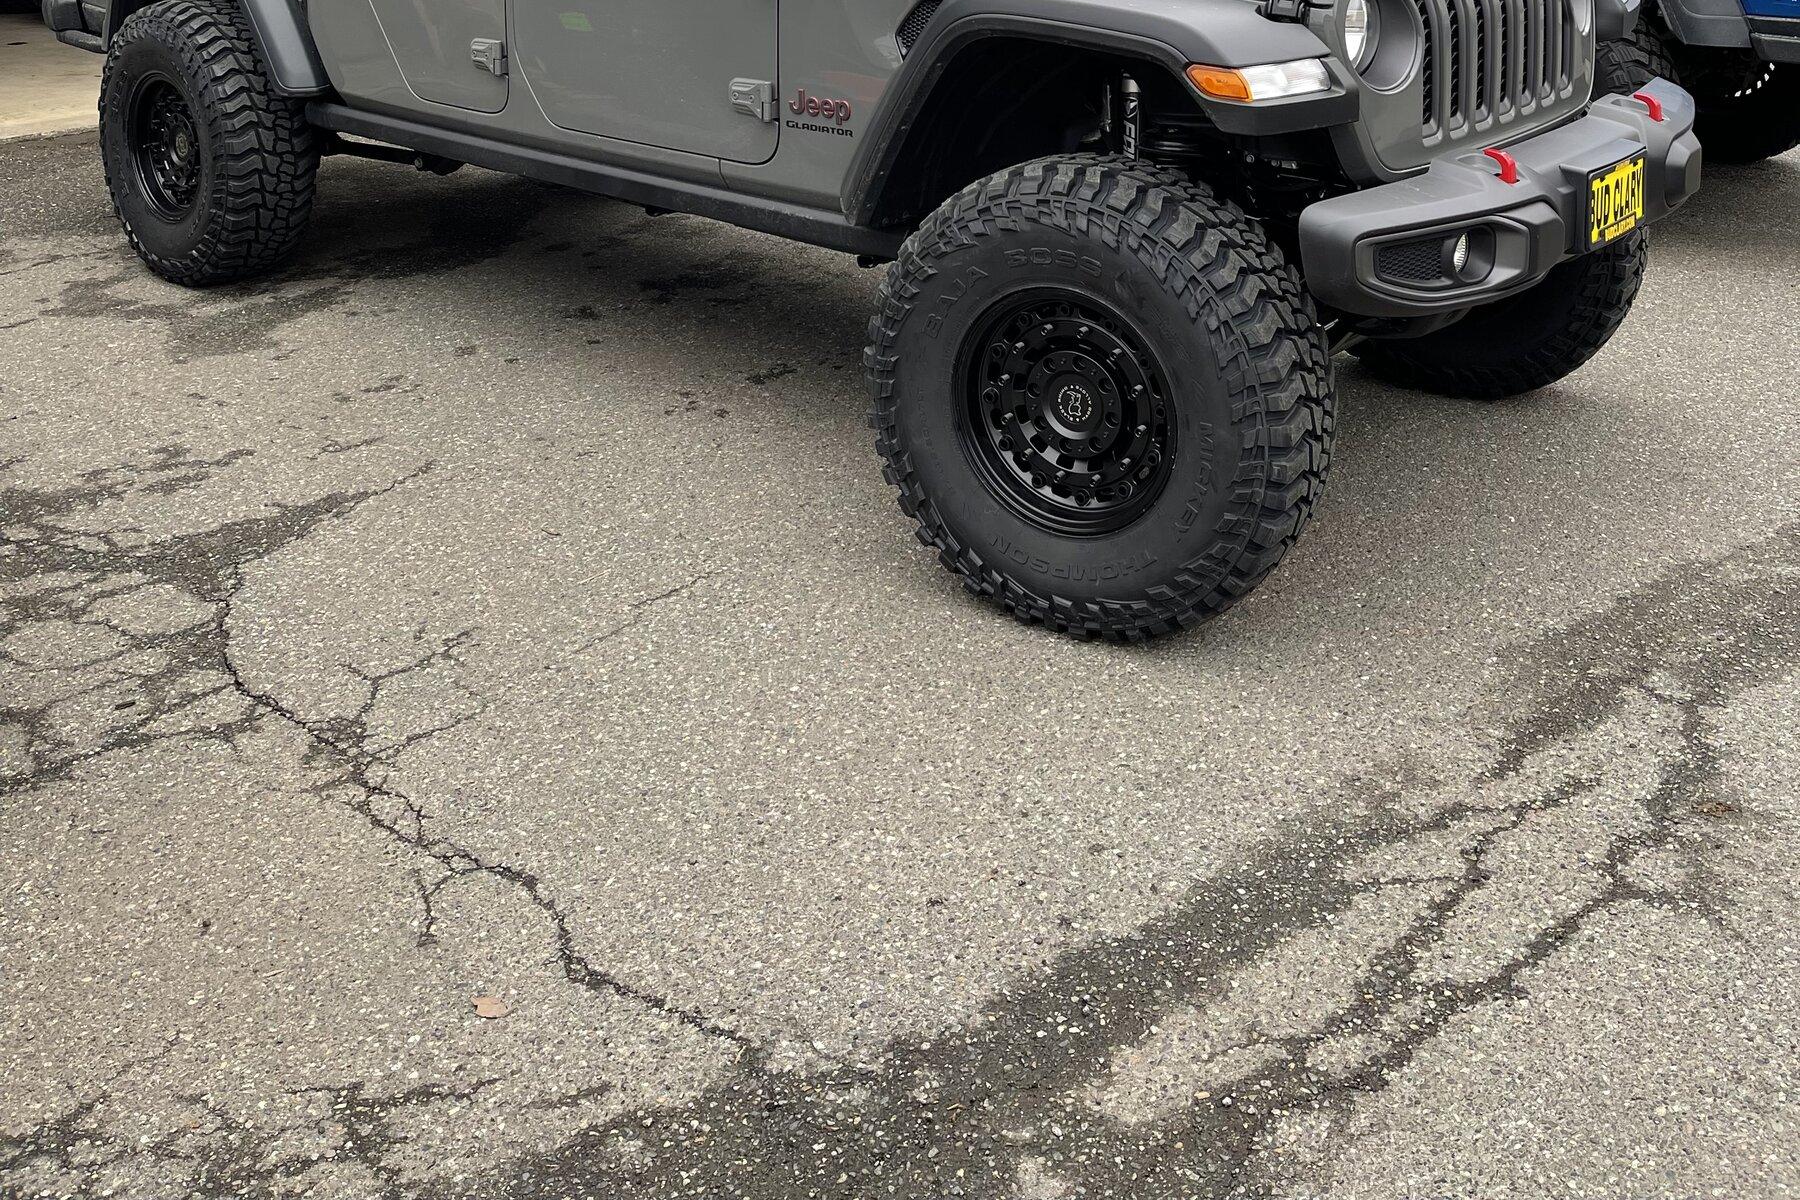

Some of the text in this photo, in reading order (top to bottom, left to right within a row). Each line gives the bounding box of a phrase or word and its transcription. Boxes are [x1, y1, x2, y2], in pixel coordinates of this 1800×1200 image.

[788, 88, 852, 126] Jeep
[786, 120, 854, 137] GLADIATOR
[1591, 168, 1644, 231] BUD CLARY
